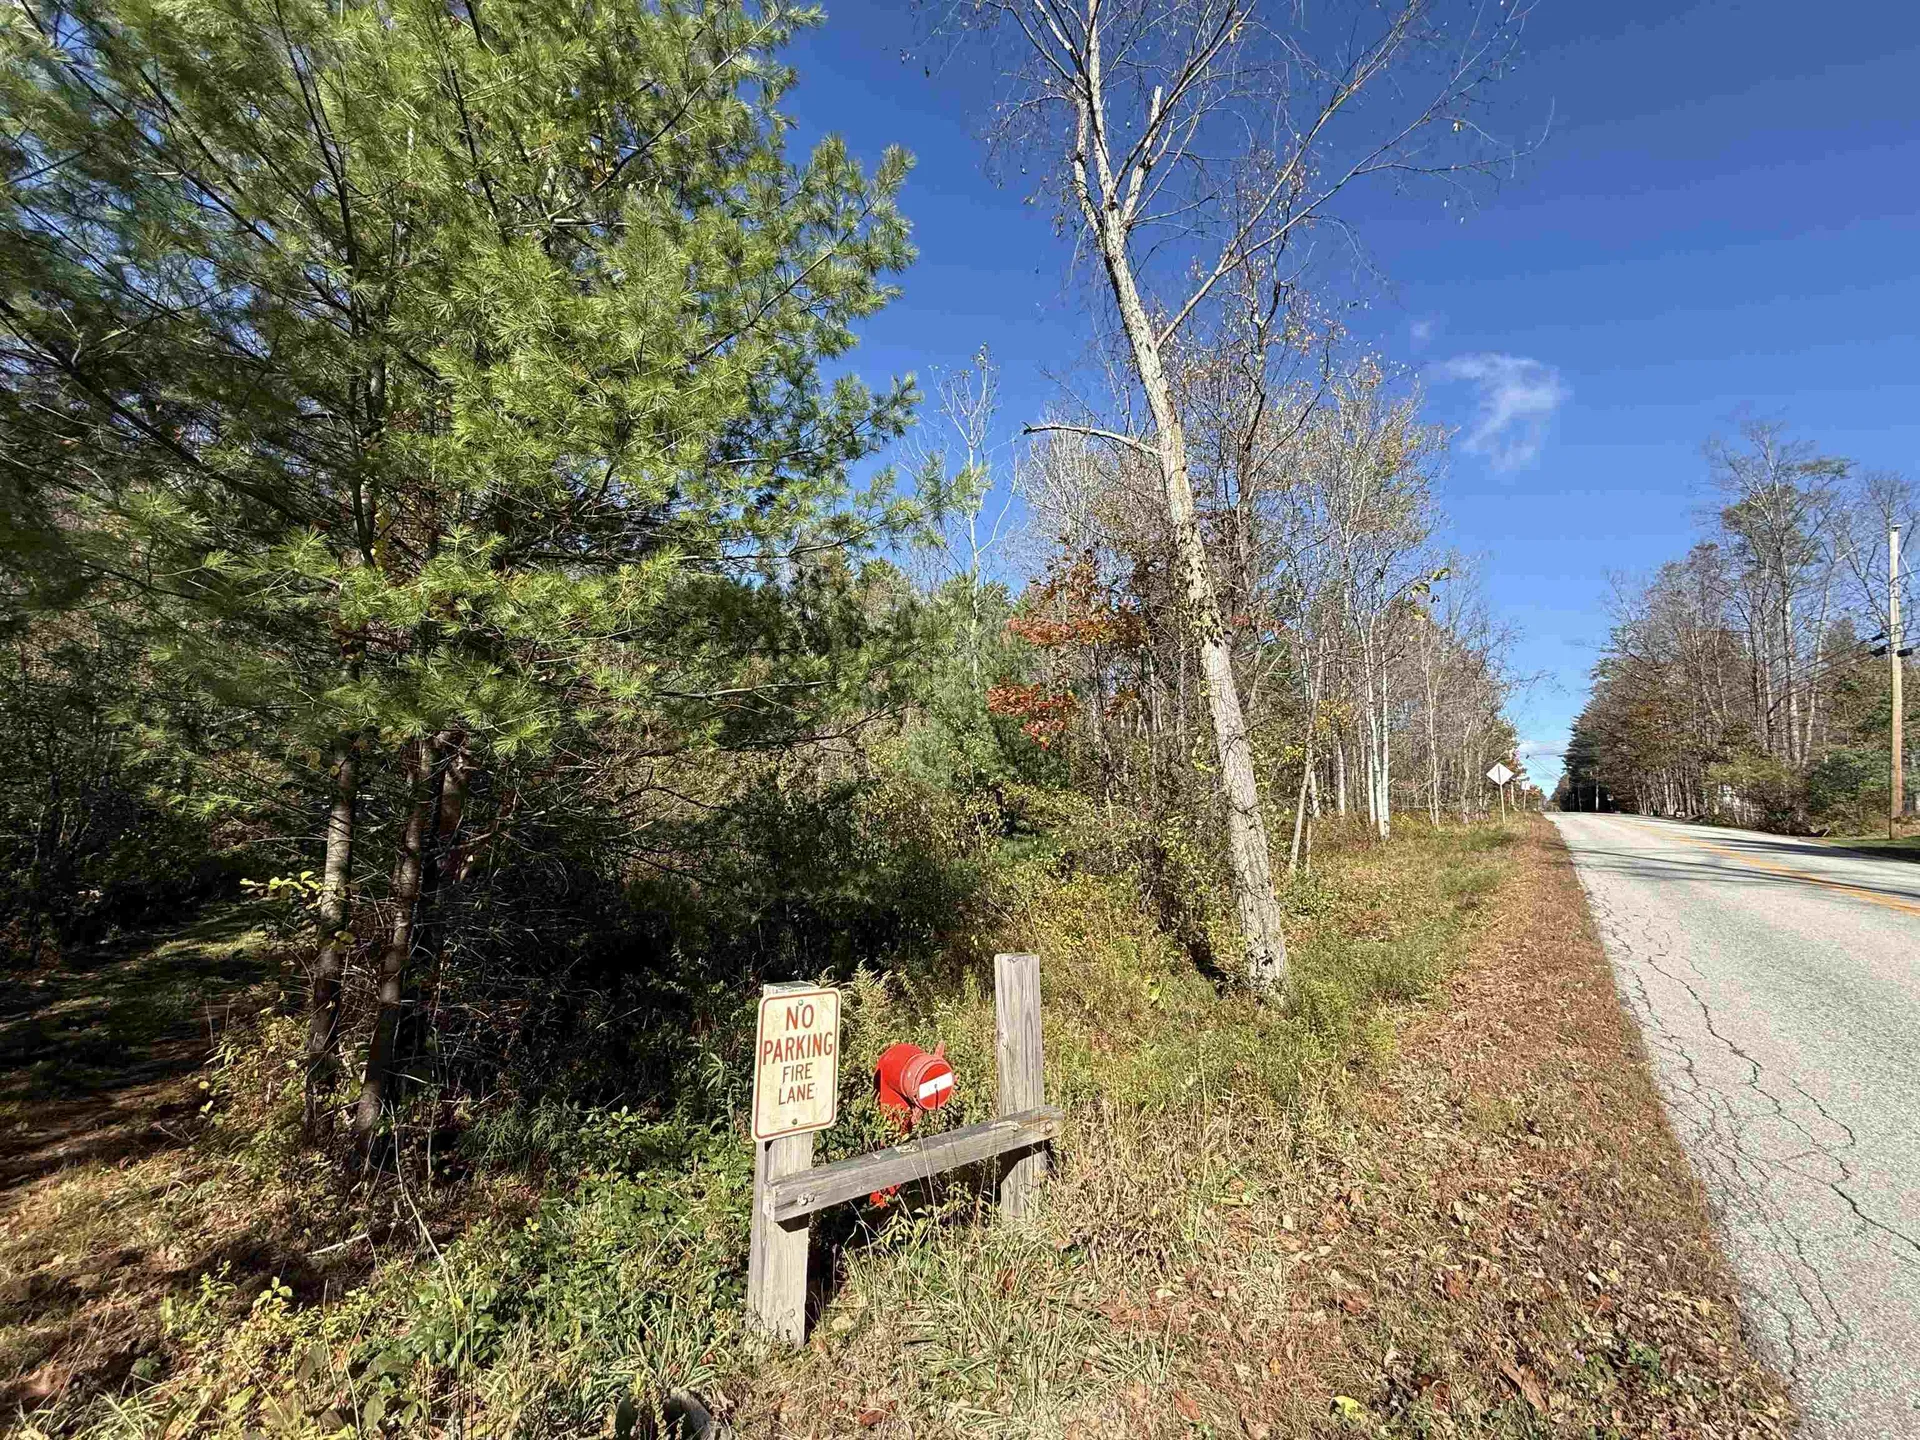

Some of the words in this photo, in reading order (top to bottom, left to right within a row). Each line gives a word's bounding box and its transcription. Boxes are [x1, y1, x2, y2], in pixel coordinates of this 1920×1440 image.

[785, 1004, 814, 1031] NO
[763, 1031, 833, 1065] PARKING
[783, 1062, 813, 1083] FIRE
[778, 1083, 815, 1105] LANE
